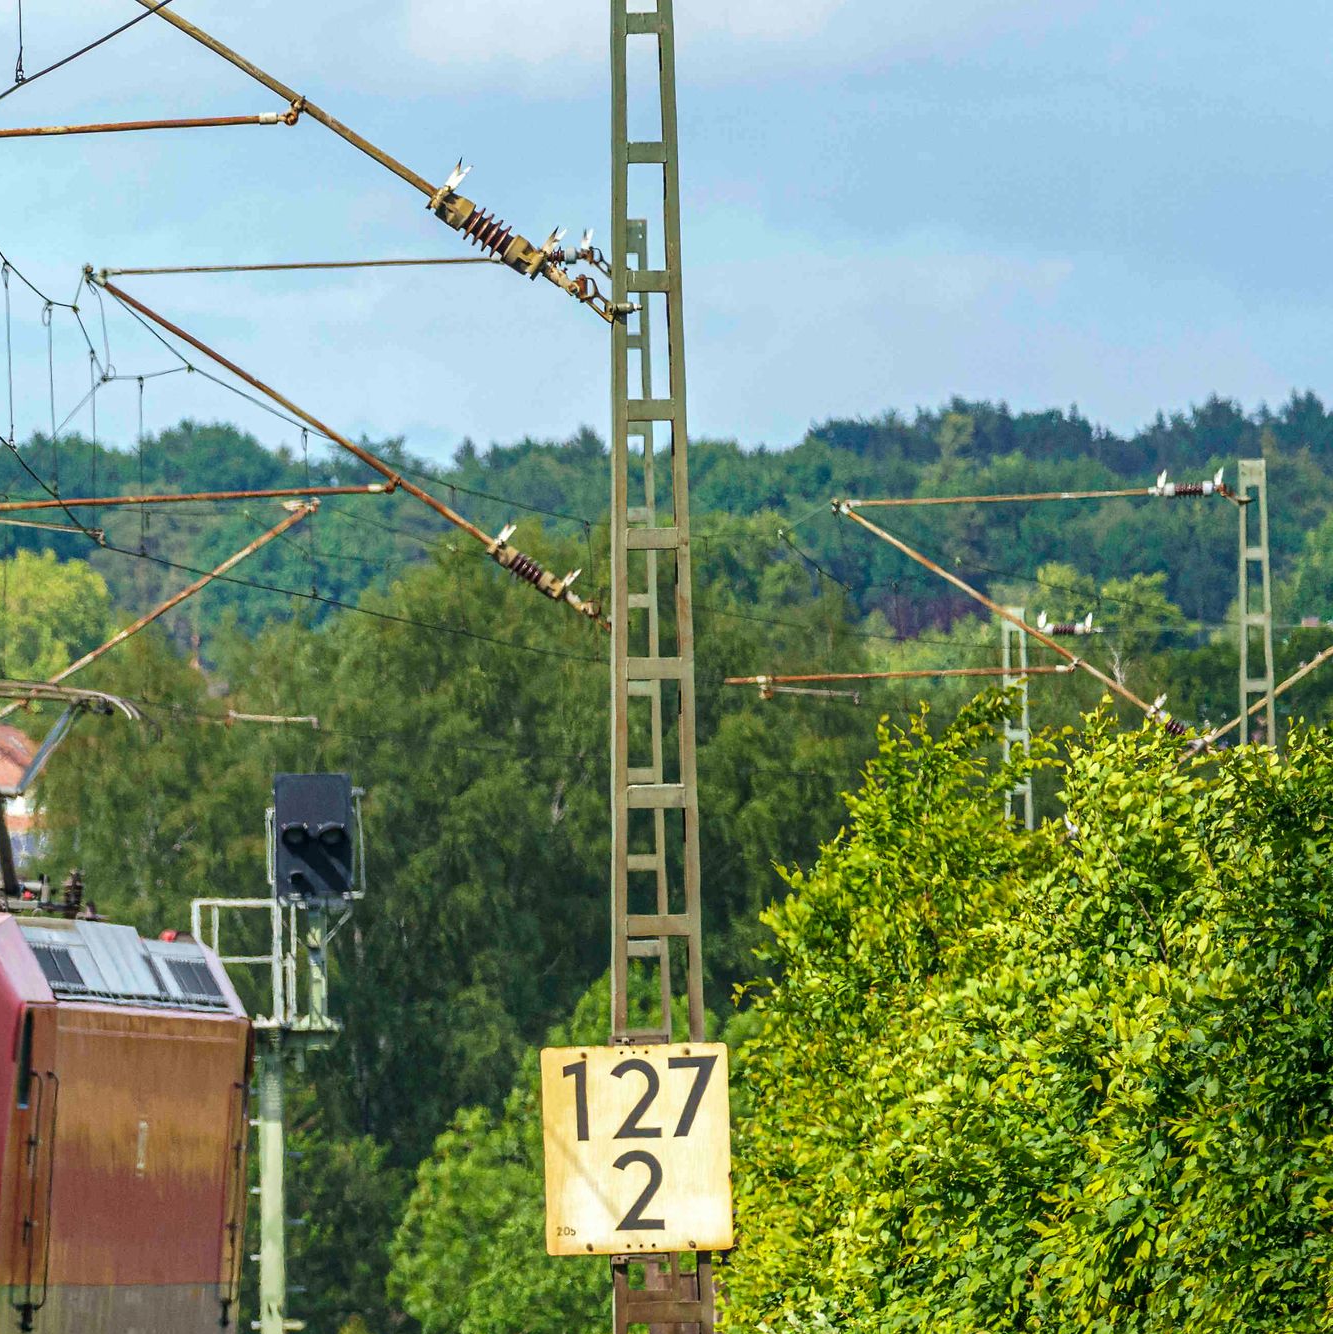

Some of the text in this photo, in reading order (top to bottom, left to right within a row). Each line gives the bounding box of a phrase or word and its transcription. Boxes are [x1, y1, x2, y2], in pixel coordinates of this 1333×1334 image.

[562, 1054, 719, 1142] 127
[556, 1225, 577, 1237] 205
[612, 1149, 666, 1231] 2
